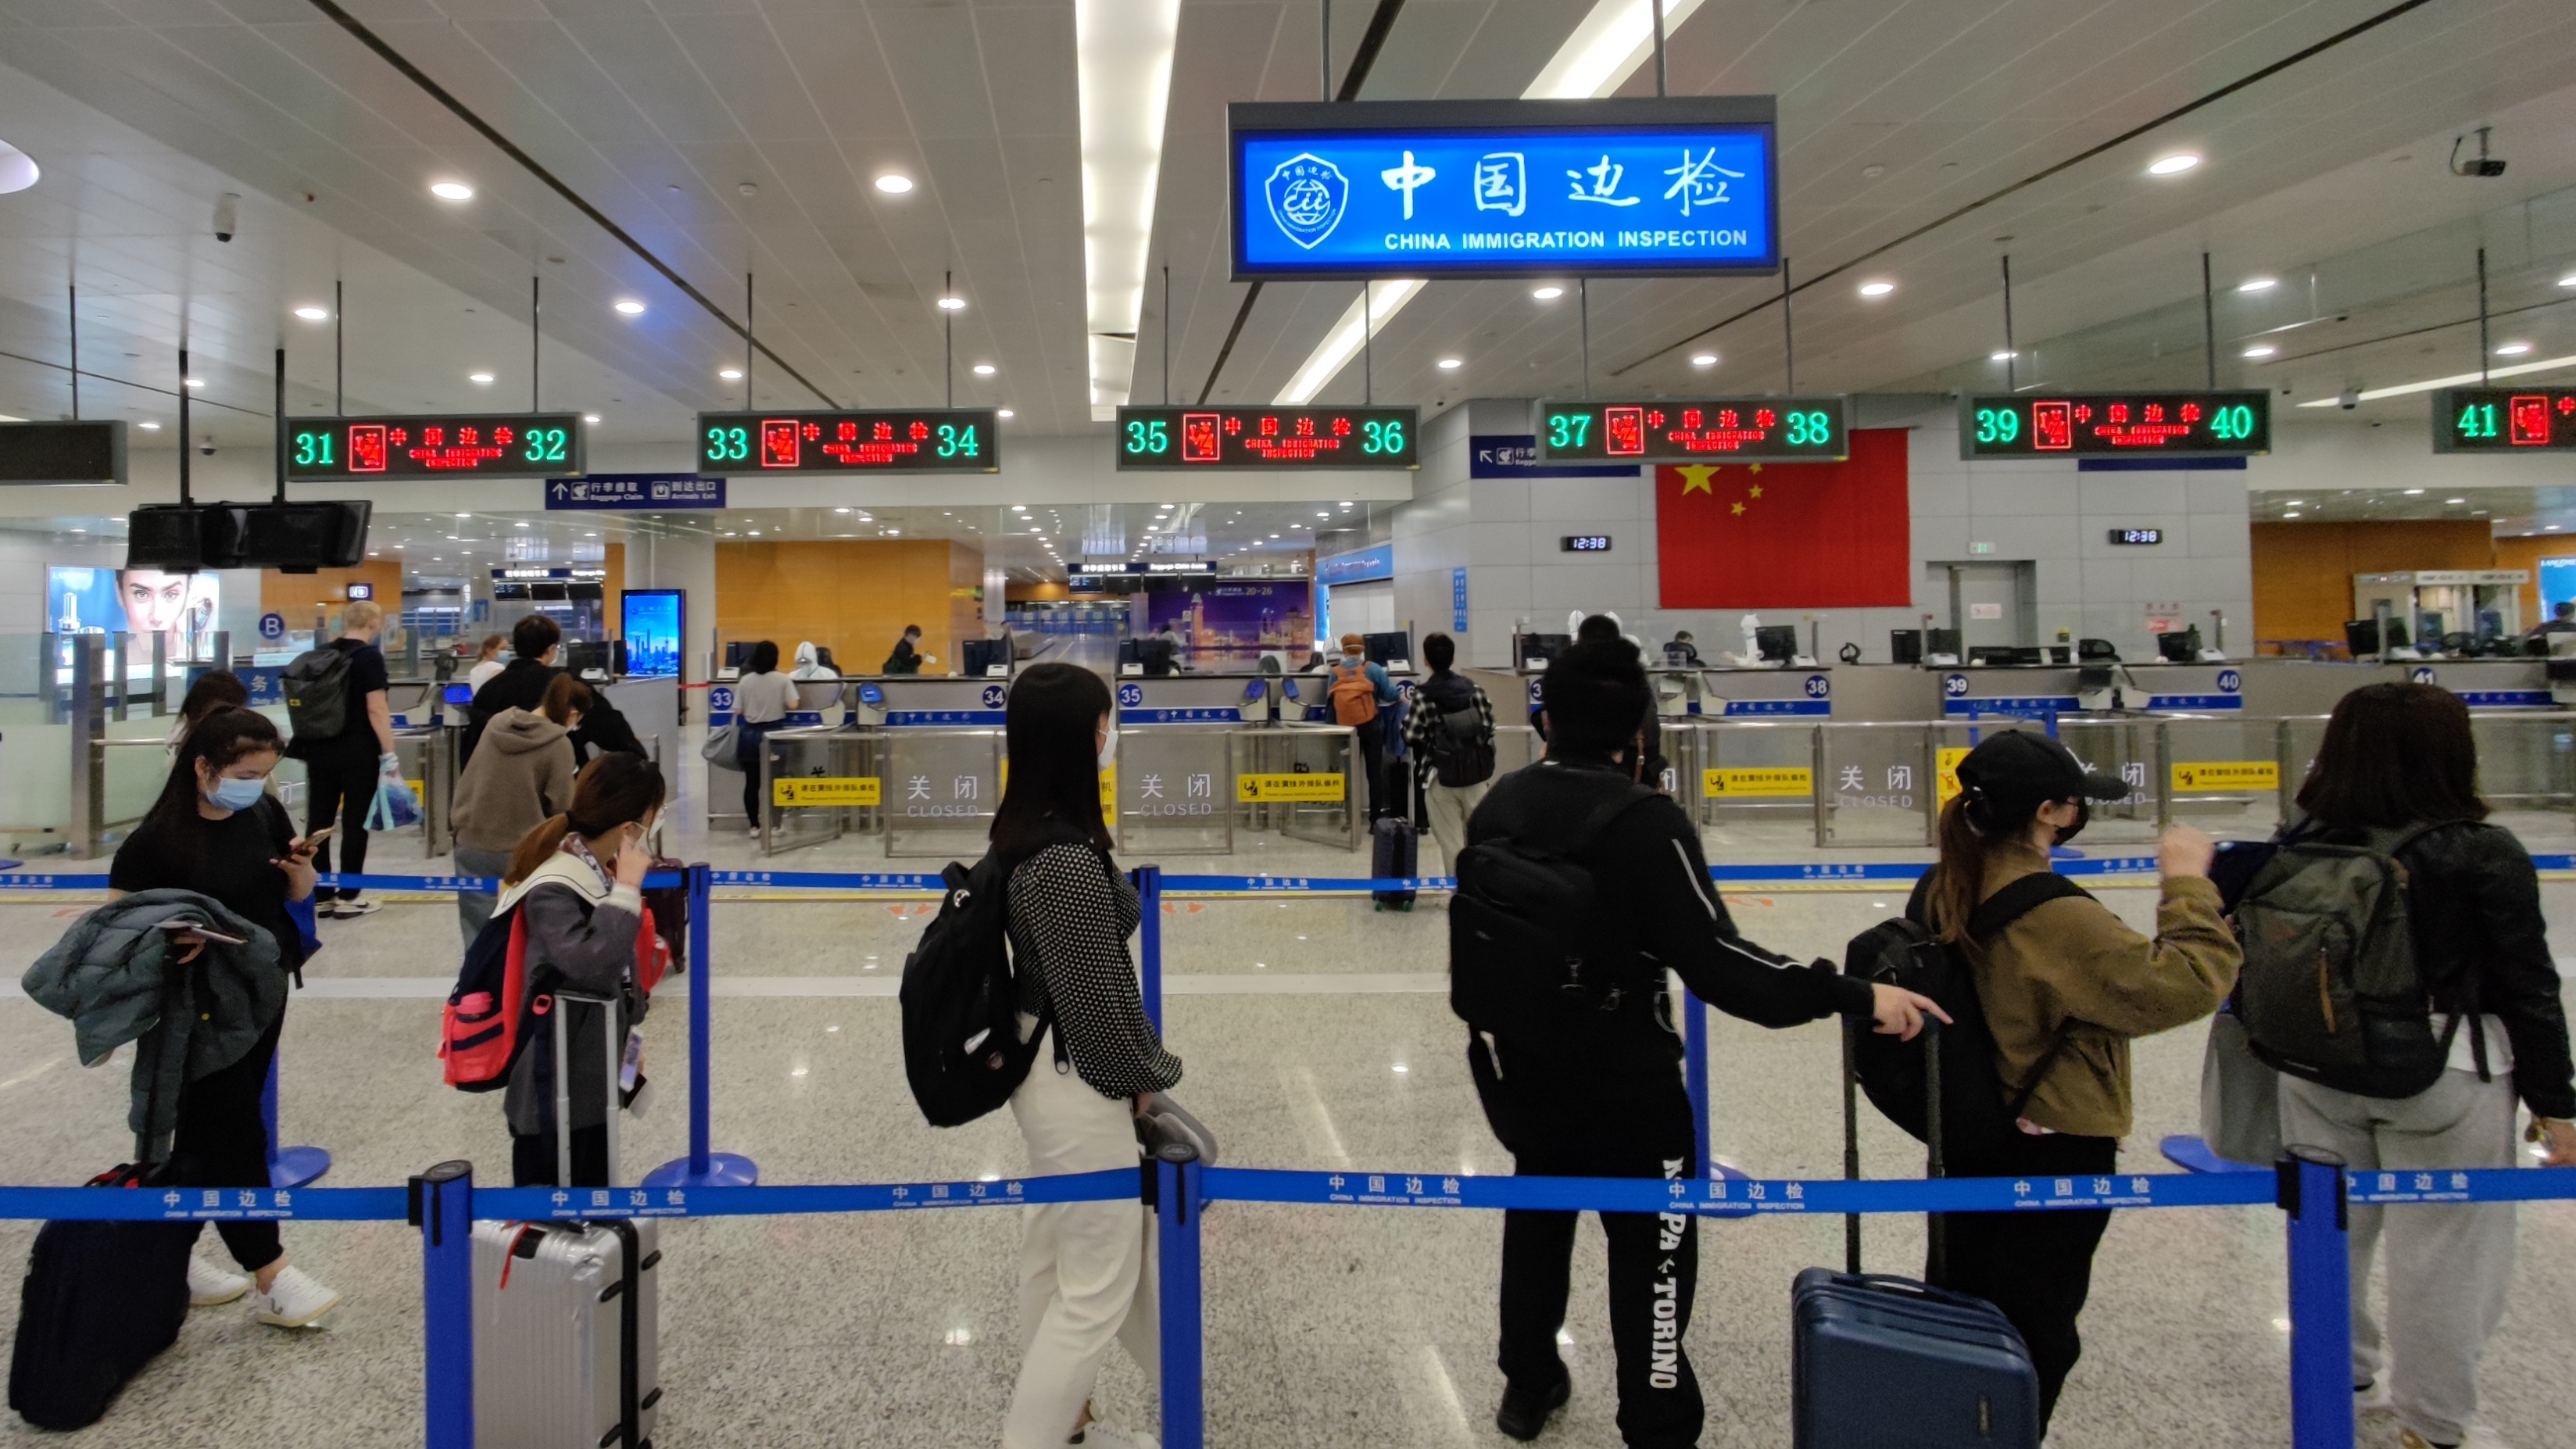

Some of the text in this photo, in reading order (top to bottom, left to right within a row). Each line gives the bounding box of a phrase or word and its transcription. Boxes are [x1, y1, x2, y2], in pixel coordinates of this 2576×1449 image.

[1380, 147, 1746, 221] 中国边检
[1384, 229, 1748, 250] CHINA IMMIGRATION INSPECTION
[1787, 412, 1830, 445] 38
[1977, 409, 2018, 442] 39
[2210, 406, 2252, 438] 40
[2457, 404, 2496, 437] 41
[937, 424, 979, 456] 34
[1127, 420, 1168, 453] 35
[1364, 421, 1404, 453] 36
[1550, 415, 1591, 447] 37
[295, 433, 333, 464] 31
[525, 429, 566, 461] 32
[707, 428, 748, 460] 33
[1573, 537, 1606, 549] 12:38
[2124, 531, 2157, 542] 12:38
[1246, 587, 1272, 596] 20-26
[265, 617, 280, 635] B
[1807, 680, 1827, 694] 38
[1947, 679, 1967, 692] 39
[2220, 674, 2239, 689] 40
[2414, 671, 2434, 685] 41
[712, 692, 732, 705] 33
[984, 689, 1004, 703] 34
[1121, 689, 1141, 702] 35
[907, 775, 978, 800] 关闭
[1140, 773, 1211, 799] 关闭
[1841, 765, 1912, 791] 关闭
[907, 805, 978, 818] CLOSED
[1140, 803, 1211, 816] CLOSED
[1841, 796, 1912, 808] CLOSED
[893, 1181, 1024, 1200] 中国边检
[1329, 1175, 1460, 1194] 中国边检
[1669, 1182, 1804, 1200] 中国边检
[2014, 1177, 2149, 1197] 中国边检
[163, 1190, 291, 1208] 中国边检
[552, 1190, 685, 1207] 中国边检
[1649, 1156, 1687, 1389] KPA TORINO
